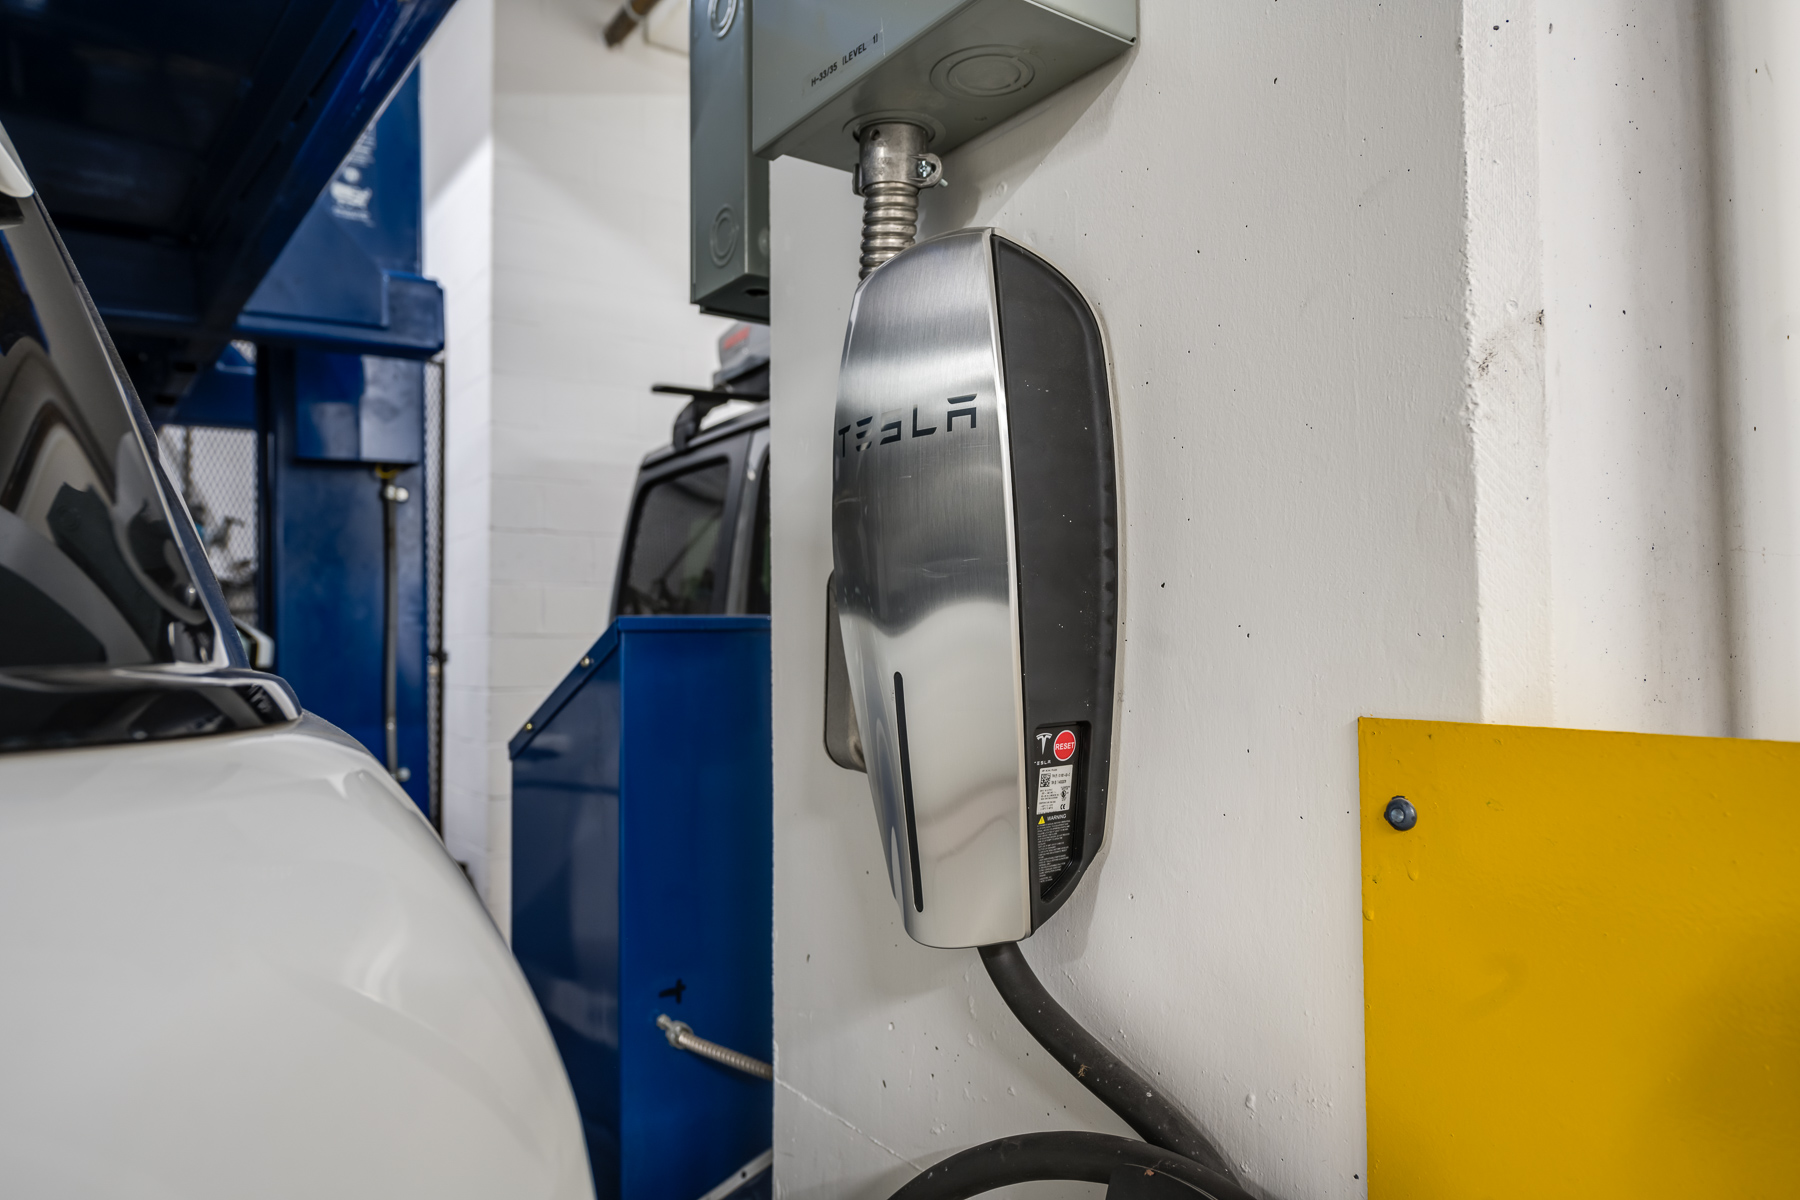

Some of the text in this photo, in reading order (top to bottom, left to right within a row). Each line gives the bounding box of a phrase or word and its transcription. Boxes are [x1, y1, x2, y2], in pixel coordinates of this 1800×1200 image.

[810, 61, 838, 87] H-33/35
[837, 393, 978, 459] TESLA
[1055, 741, 1075, 751] RESET
[1046, 813, 1067, 821] WARNING
